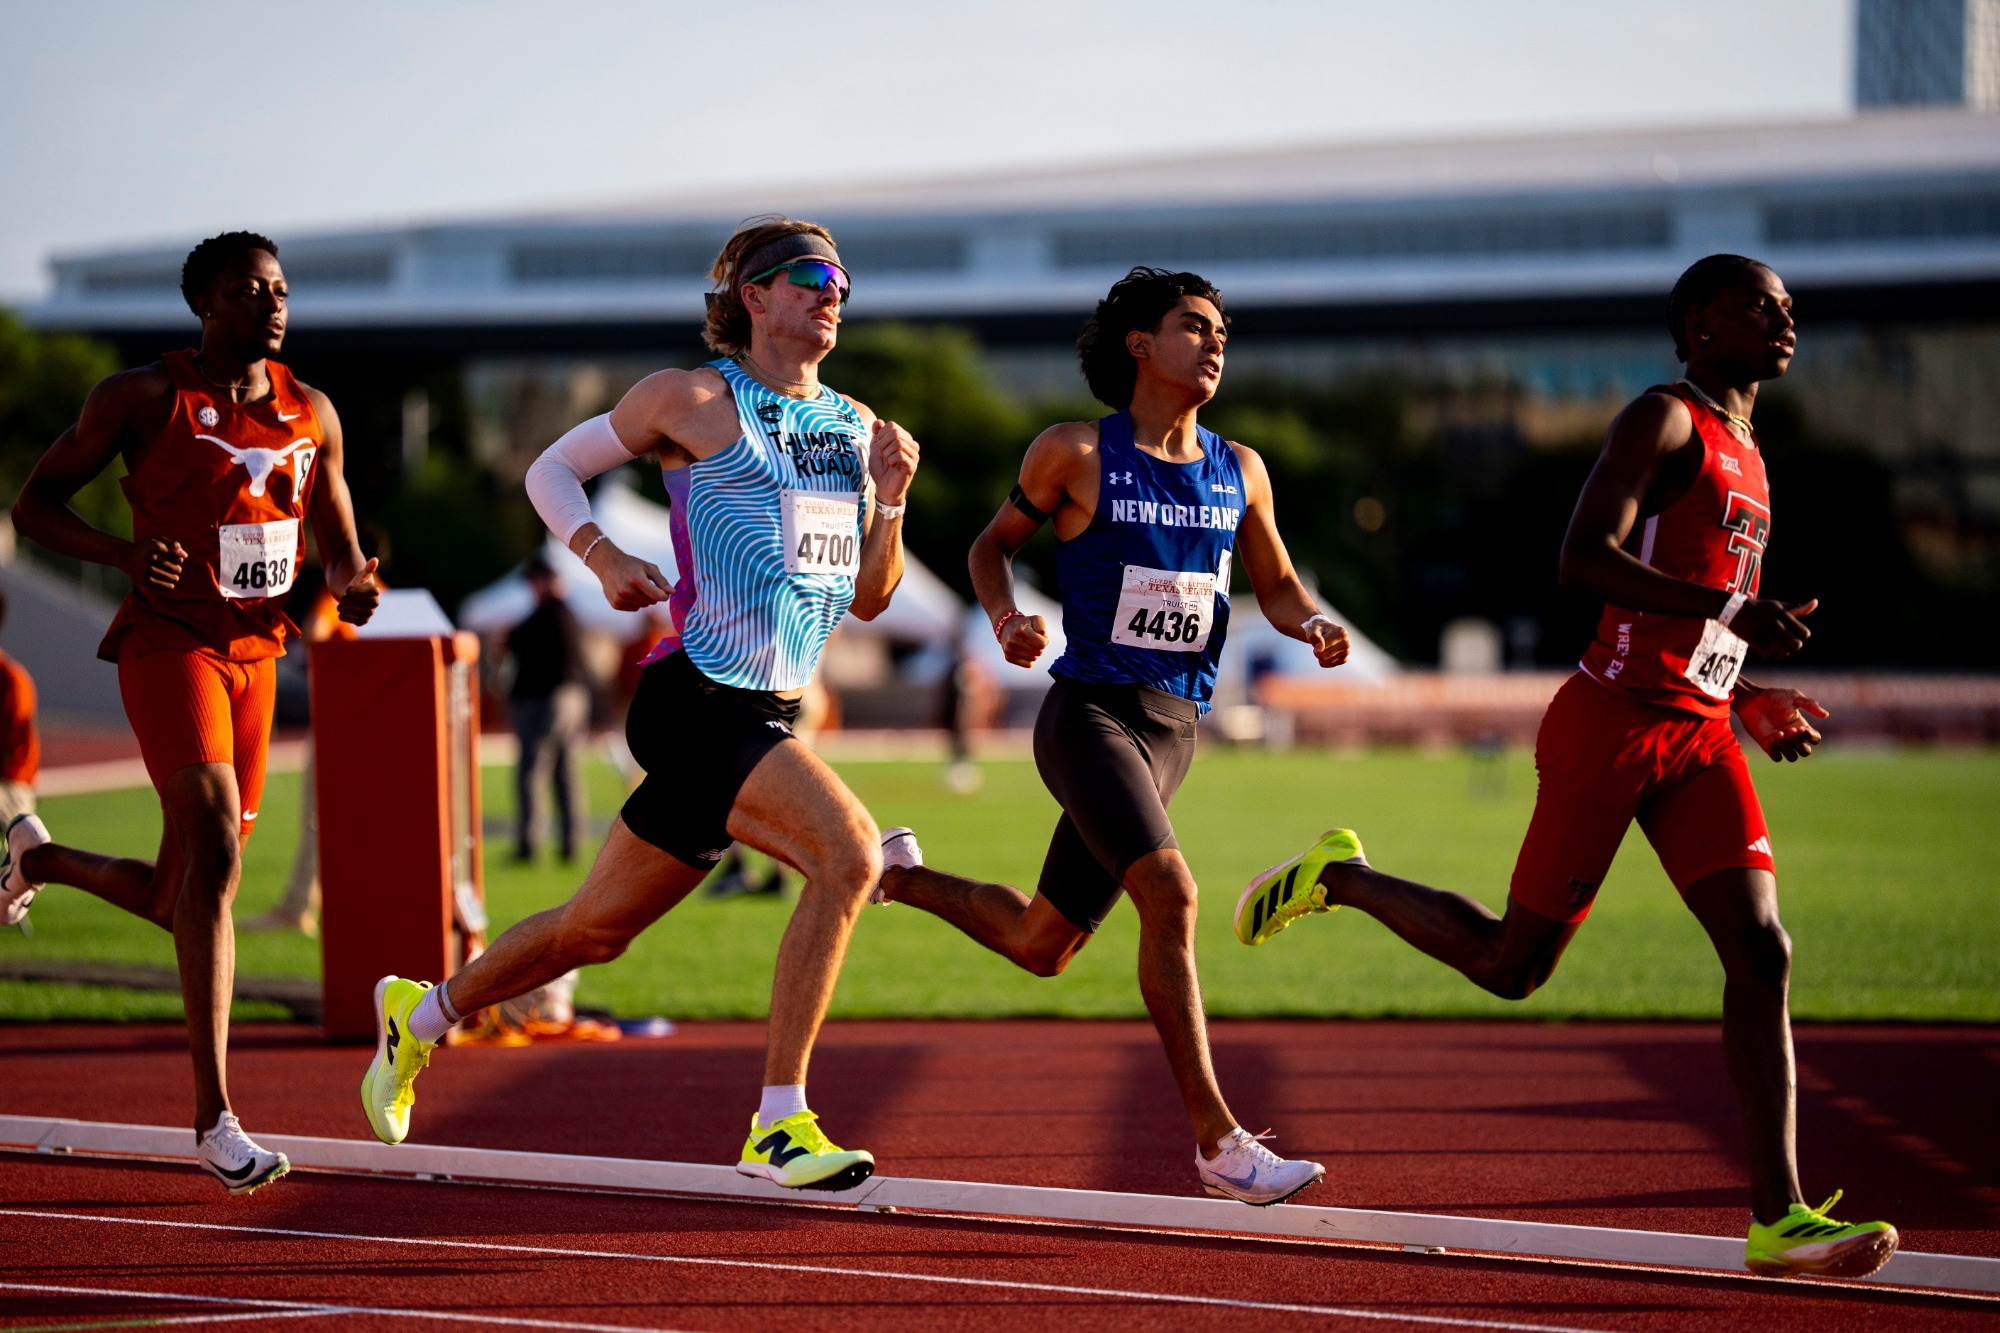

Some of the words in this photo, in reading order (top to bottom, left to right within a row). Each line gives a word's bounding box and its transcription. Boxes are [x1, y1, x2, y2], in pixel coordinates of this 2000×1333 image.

[200, 408, 218, 425] SEC
[768, 431, 857, 455] THUNDE
[802, 443, 835, 461] elite
[793, 453, 853, 478] ROAD
[804, 505, 836, 515] TEXAS
[1111, 499, 1158, 524] NEW
[1161, 503, 1239, 531] ORLEANS
[821, 521, 844, 530] TRUIST
[797, 532, 853, 567] 4700
[232, 557, 288, 589] 4638
[1149, 577, 1173, 586] CLYDE
[1148, 582, 1180, 594] TEXAS
[1162, 599, 1188, 609] TRUIST
[1128, 608, 1200, 643] 4436
[1698, 652, 1737, 688] 467
